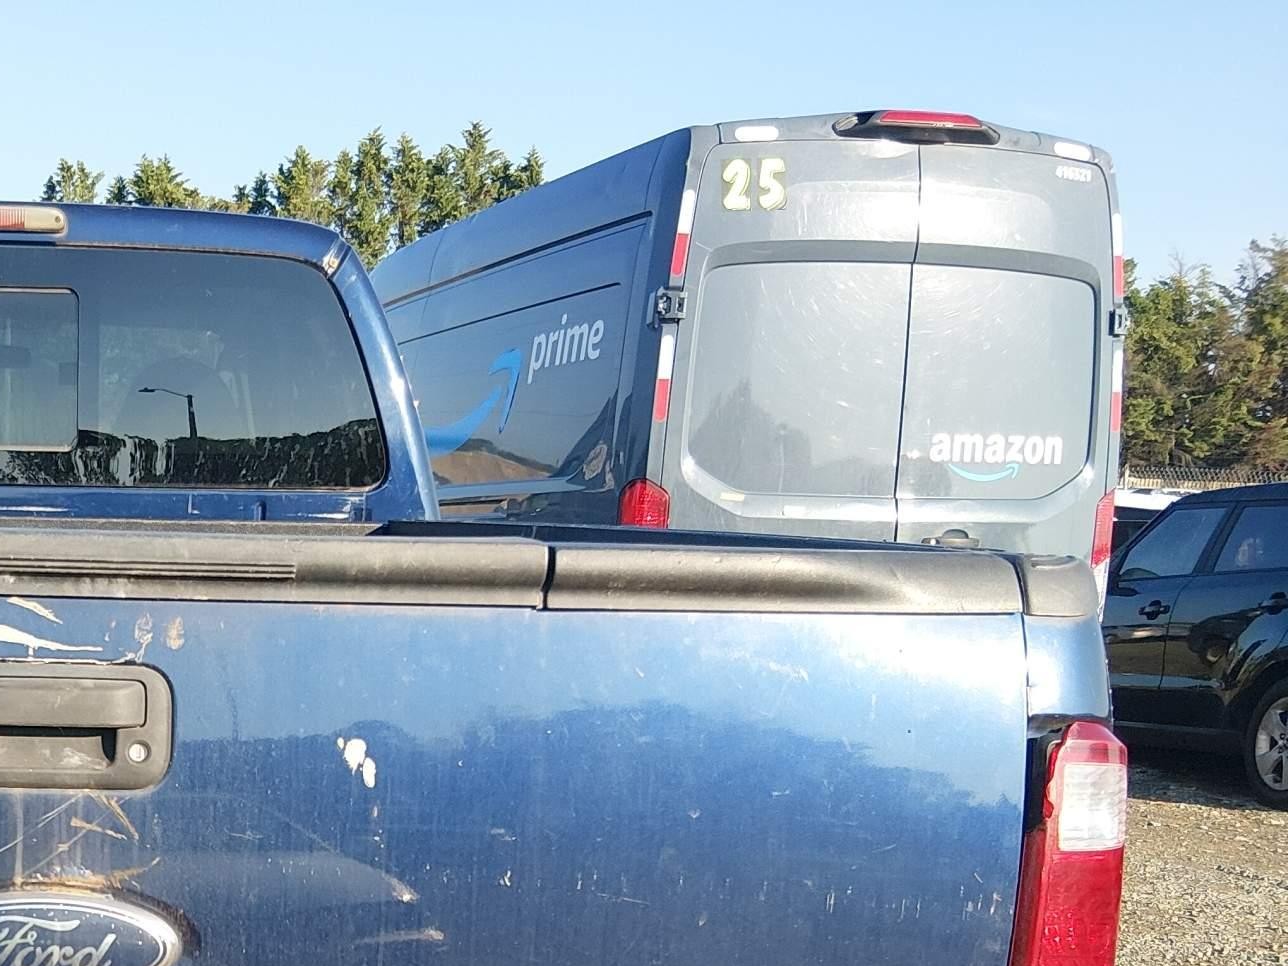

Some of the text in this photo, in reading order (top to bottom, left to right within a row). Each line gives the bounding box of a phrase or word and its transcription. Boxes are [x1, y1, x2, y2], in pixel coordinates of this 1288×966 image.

[722, 158, 787, 211] 25
[526, 312, 605, 385] prime
[929, 431, 1064, 465] amazon
